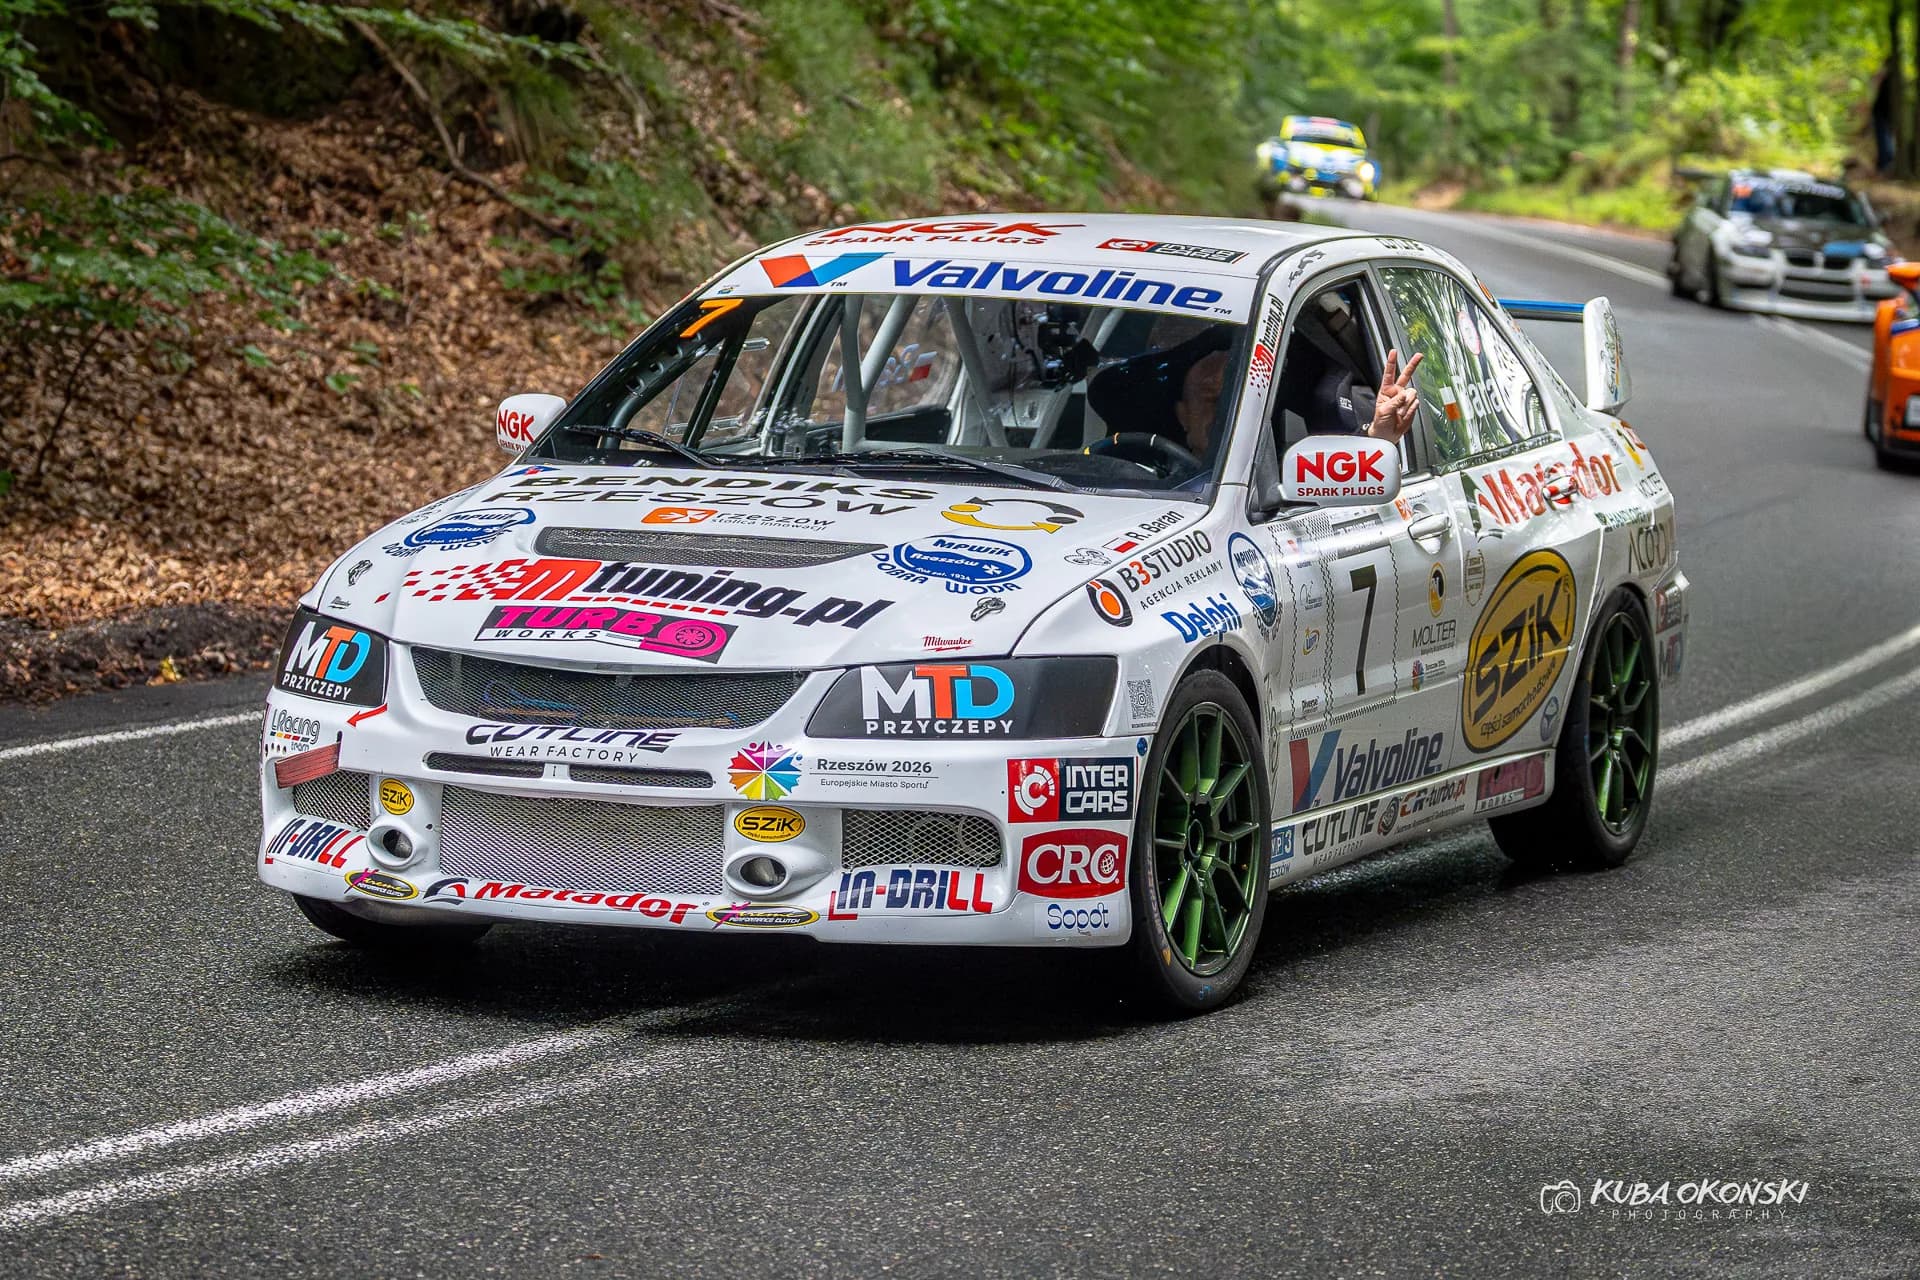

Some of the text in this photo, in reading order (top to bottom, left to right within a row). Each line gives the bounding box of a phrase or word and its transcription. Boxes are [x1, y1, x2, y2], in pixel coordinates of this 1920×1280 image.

[803, 234, 1048, 246] SPARK PLUGS
[818, 221, 1087, 238] NGK
[894, 258, 1223, 311] Valvoline
[680, 298, 744, 338] 7
[498, 408, 535, 445] NGK
[1296, 449, 1385, 483] NGK
[510, 475, 939, 500] BENDIKS
[1297, 486, 1385, 497] SPARK PLUGS
[481, 490, 918, 515] RZESZÓW
[1148, 509, 1185, 534] Baran
[871, 552, 929, 584] DOBRA
[1116, 530, 1212, 593] B3STUDIO
[945, 580, 1022, 596] WODA
[1140, 560, 1224, 610] AGENCJA REKLAMY
[1160, 592, 1243, 643] Delphi
[1349, 564, 1378, 696] 7
[495, 629, 600, 640] WORKS
[922, 635, 974, 648] Milwaukee
[285, 621, 372, 684] MTD
[1472, 576, 1563, 726] SZiK
[281, 673, 352, 701] PRZYCZEPY
[860, 664, 1015, 719] MTD
[465, 724, 682, 753] CUTLINE
[866, 719, 1014, 735] PRZYCZEPY
[490, 746, 639, 763] WEAR FACTORY
[817, 758, 933, 774] Rzeszów 2026
[1332, 727, 1444, 803] Valvoline
[820, 778, 929, 789] Europejskie Miasto Sportu
[1065, 763, 1129, 789] INTER
[382, 787, 409, 807] SZiK
[1065, 790, 1128, 813] CARS
[741, 816, 800, 832] SZiK
[1027, 843, 1120, 884] CRC
[474, 881, 698, 925] Matador
[1047, 903, 1110, 930] Sopot
